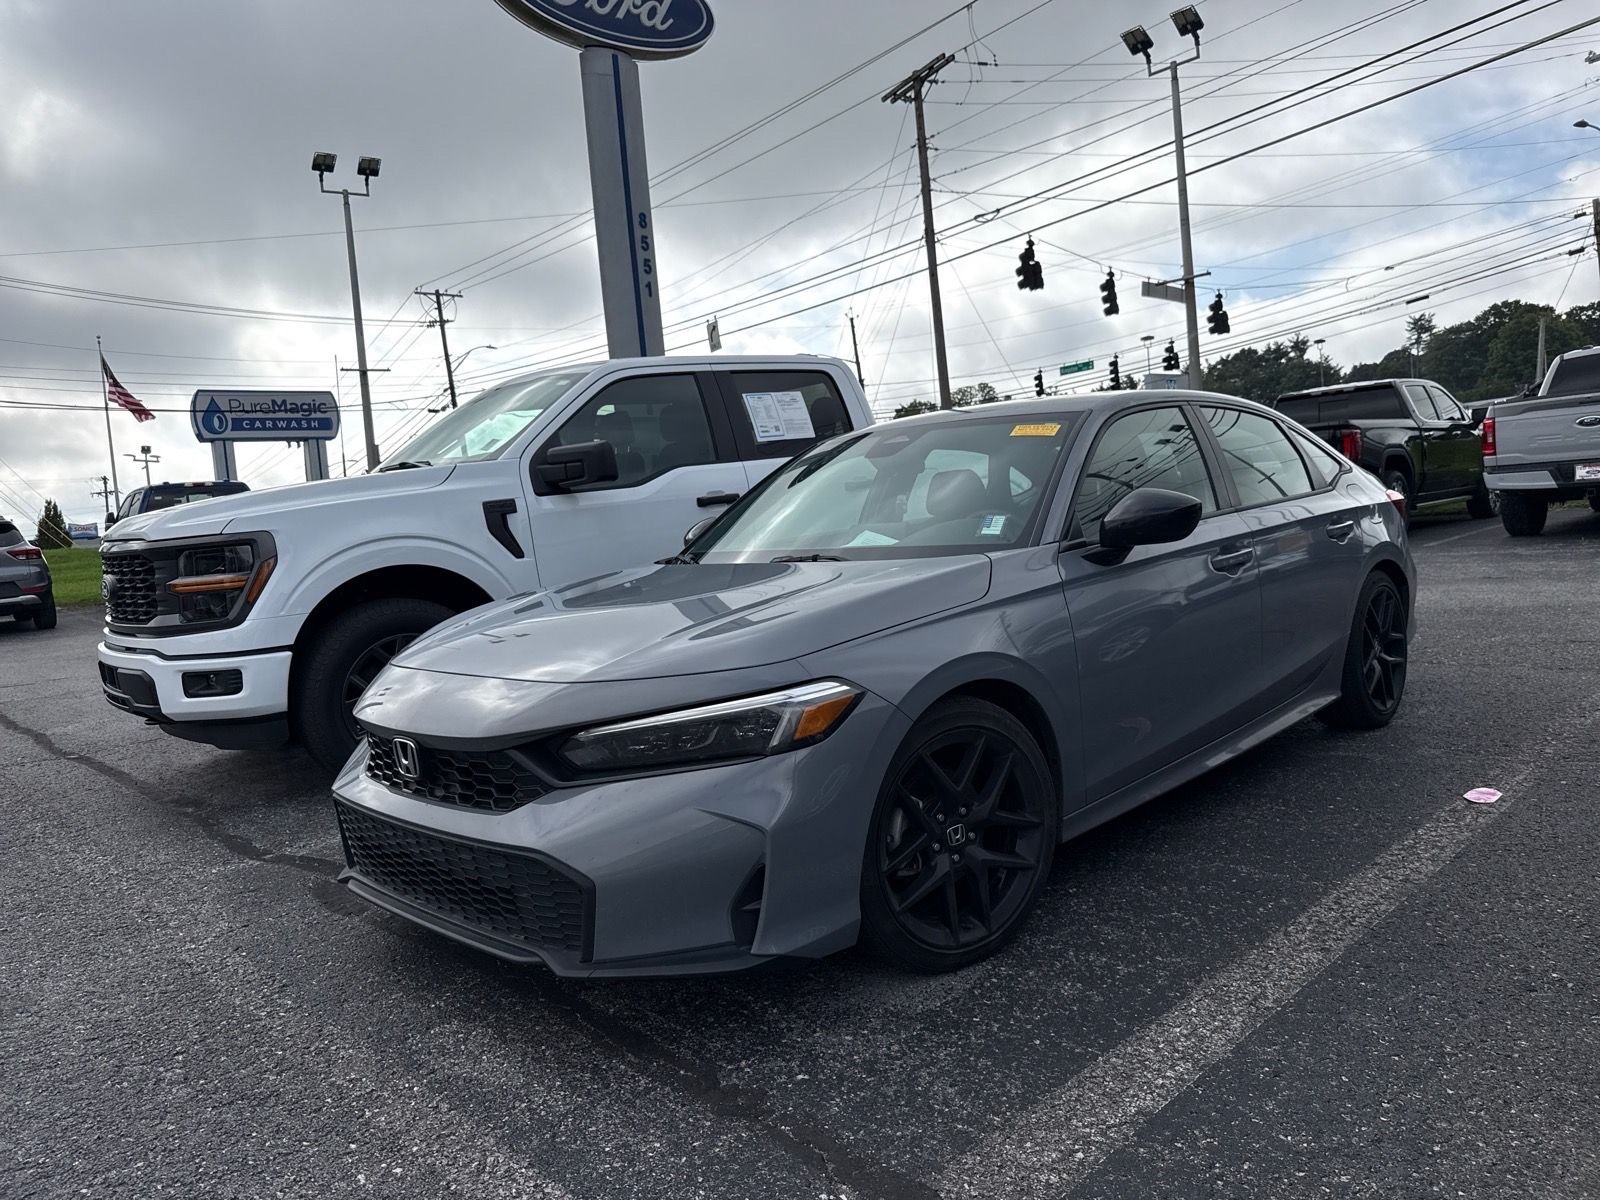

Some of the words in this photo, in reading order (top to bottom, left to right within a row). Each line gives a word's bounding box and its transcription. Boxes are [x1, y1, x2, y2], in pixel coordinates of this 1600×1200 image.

[554, 0, 674, 30] ord
[638, 212, 653, 298] 8551
[228, 398, 329, 417] PureMagic
[242, 420, 319, 428] CARWASH
